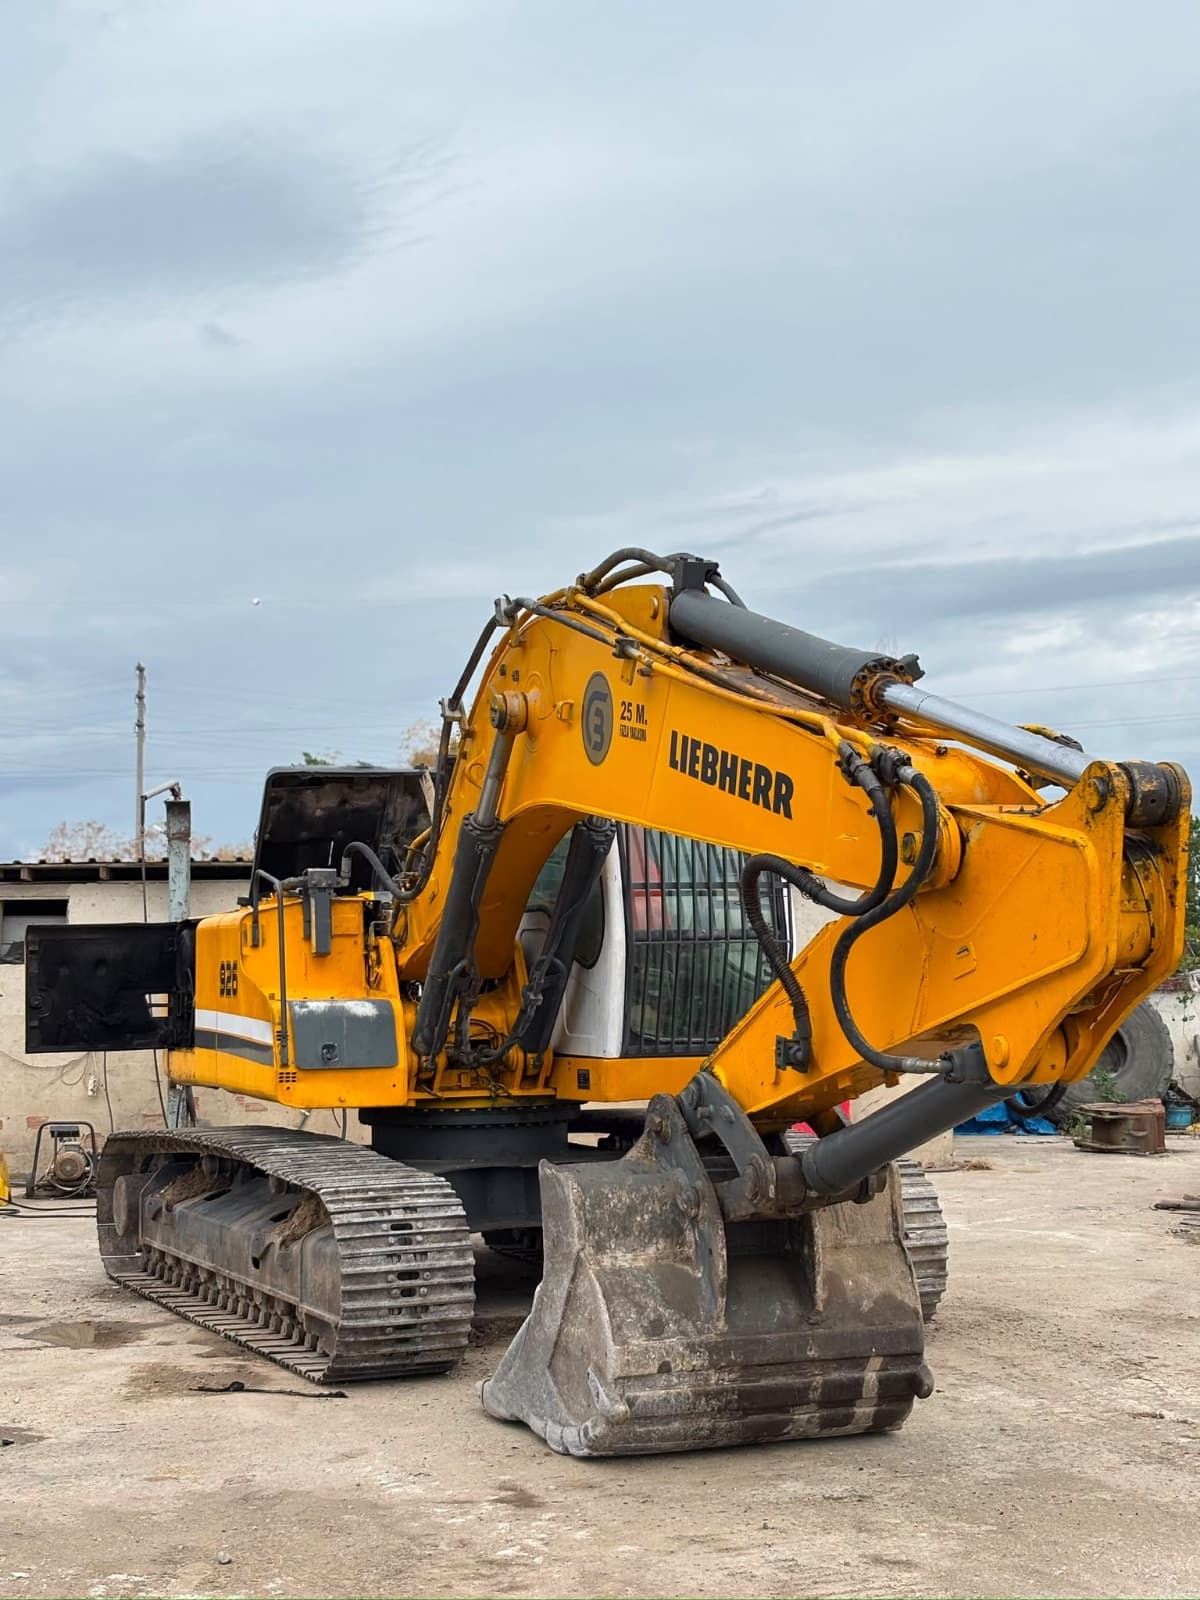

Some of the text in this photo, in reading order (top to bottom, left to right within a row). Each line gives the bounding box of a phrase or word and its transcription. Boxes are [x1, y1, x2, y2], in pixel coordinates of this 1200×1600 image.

[620, 700, 648, 726] 25 M.
[669, 730, 794, 820] LIEBHERR
[220, 960, 238, 997] 926
